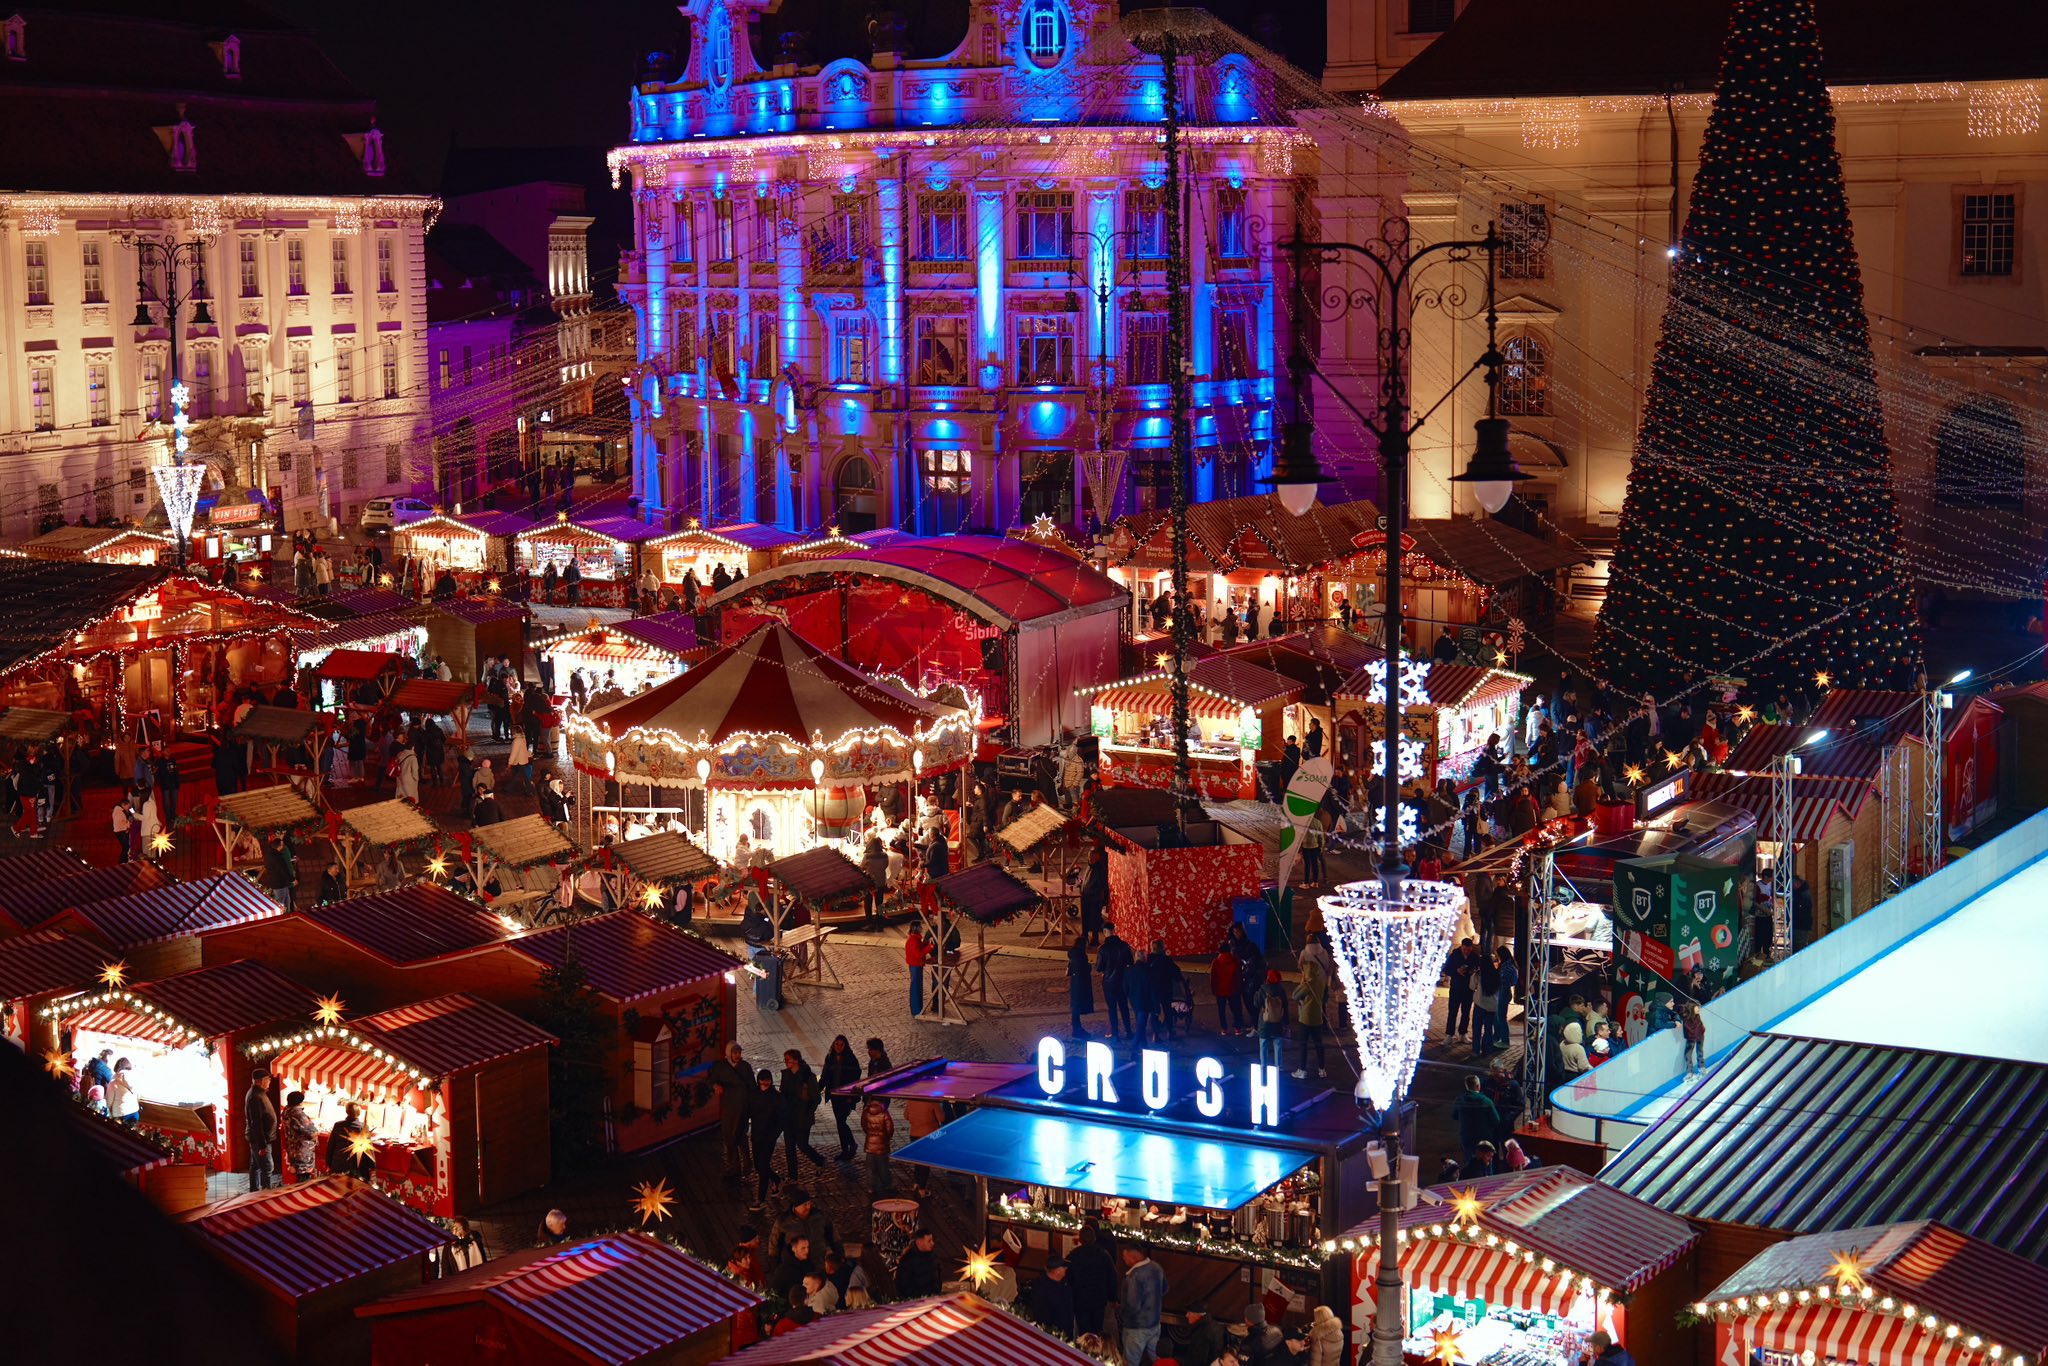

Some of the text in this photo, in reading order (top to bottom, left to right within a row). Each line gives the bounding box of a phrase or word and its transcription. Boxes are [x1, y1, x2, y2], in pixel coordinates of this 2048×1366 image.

[214, 507, 259, 519] VIN FIERT
[1303, 774, 1328, 783] SOMA
[1636, 895, 1648, 907] BT
[1698, 897, 1712, 909] BT
[1037, 1036, 1280, 1127] CRUSH
